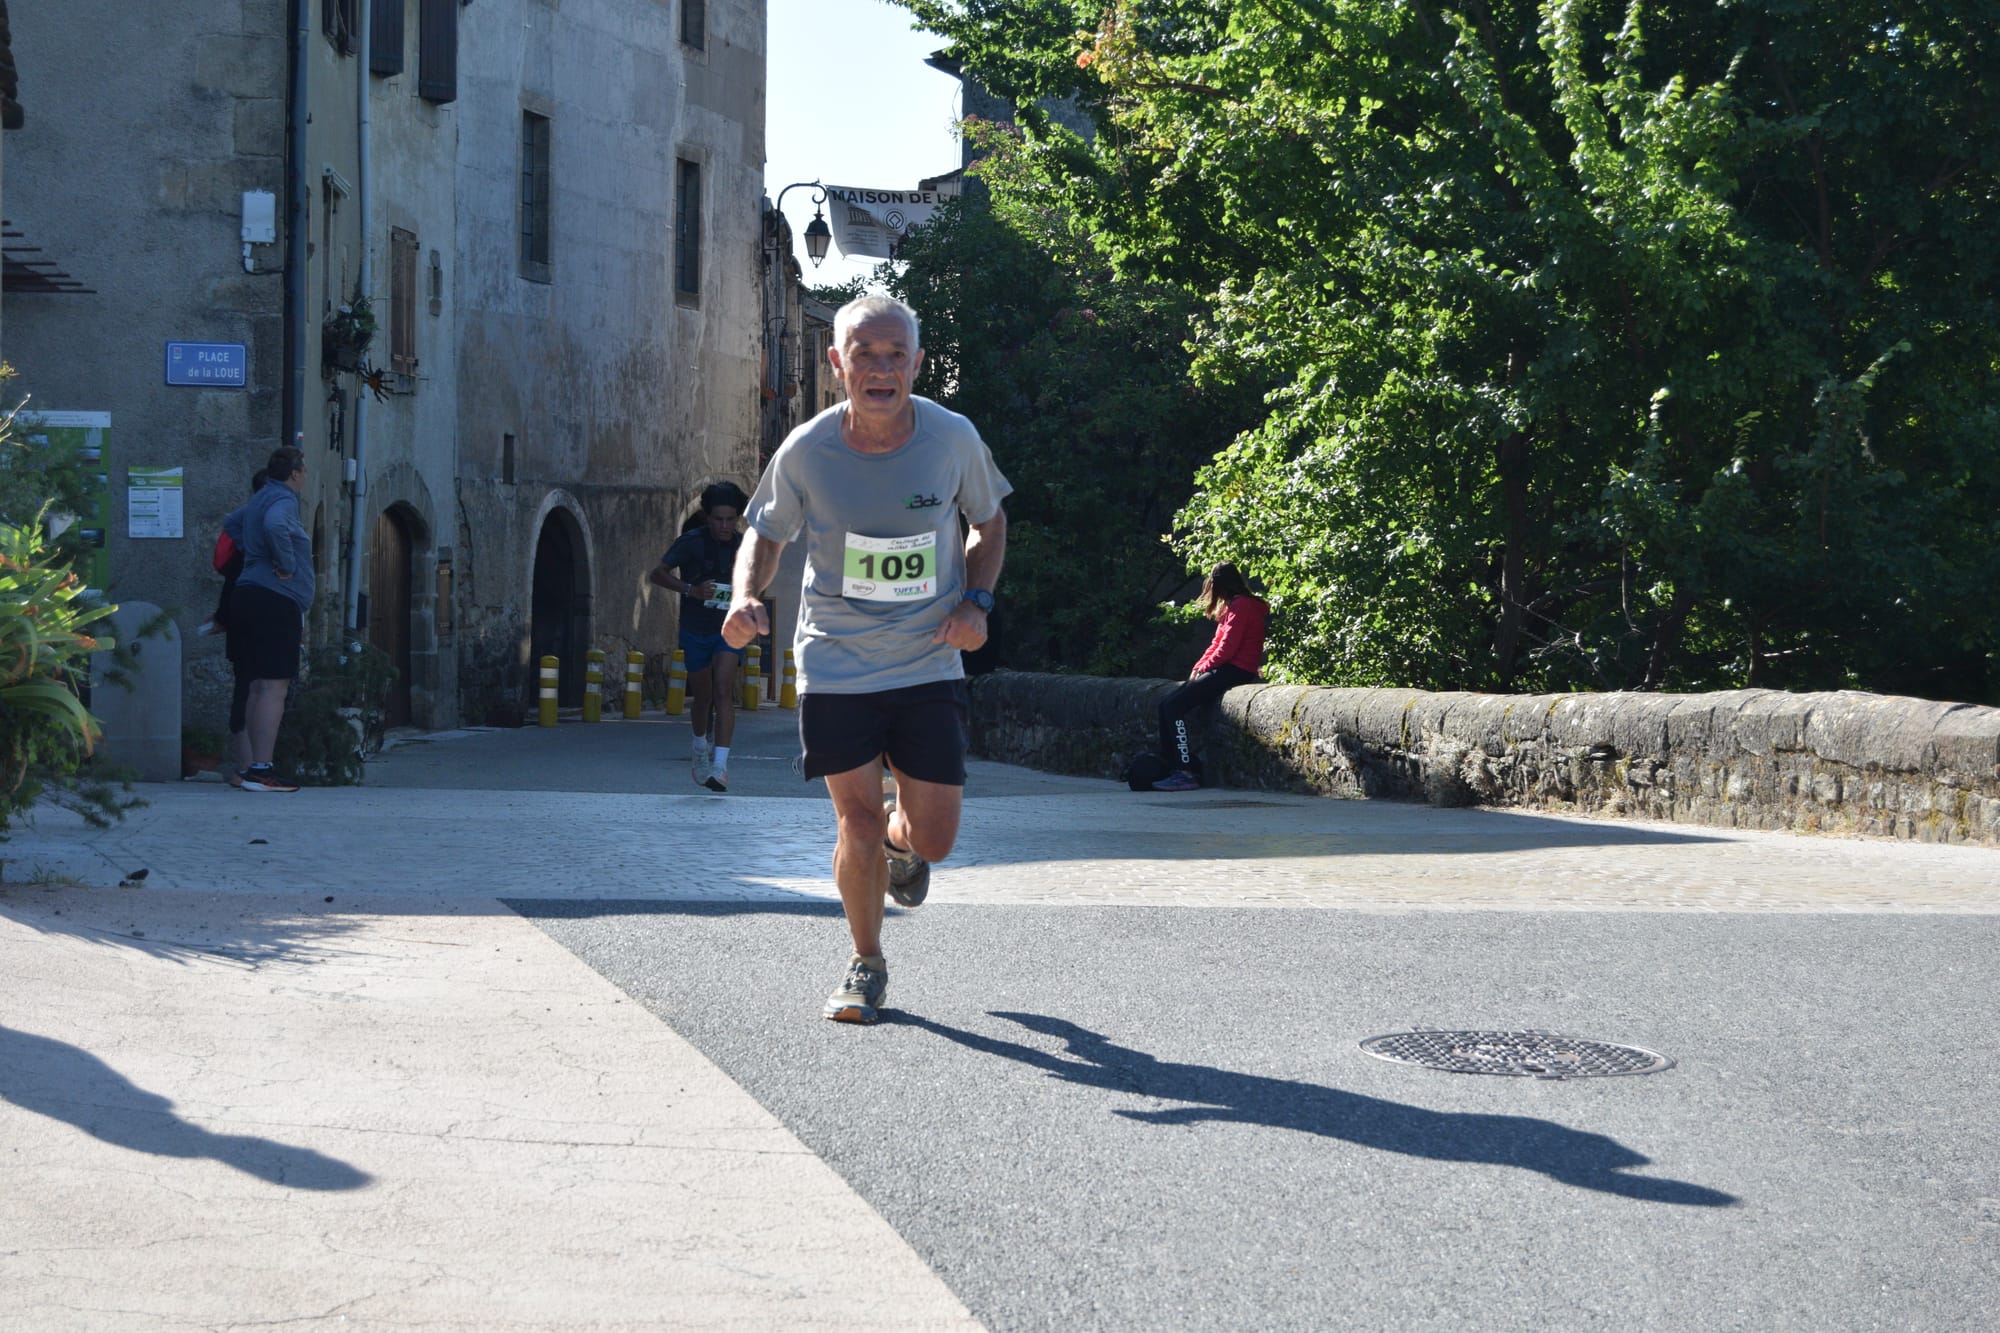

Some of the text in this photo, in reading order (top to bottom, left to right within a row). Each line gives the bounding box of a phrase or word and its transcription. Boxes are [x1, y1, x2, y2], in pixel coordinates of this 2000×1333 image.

[832, 189, 903, 205] MAISON
[909, 192, 932, 204] DE
[198, 351, 230, 362] PLACE
[187, 367, 240, 378] de la LOUE
[858, 553, 925, 580] 109
[1175, 719, 1190, 763] adidas
